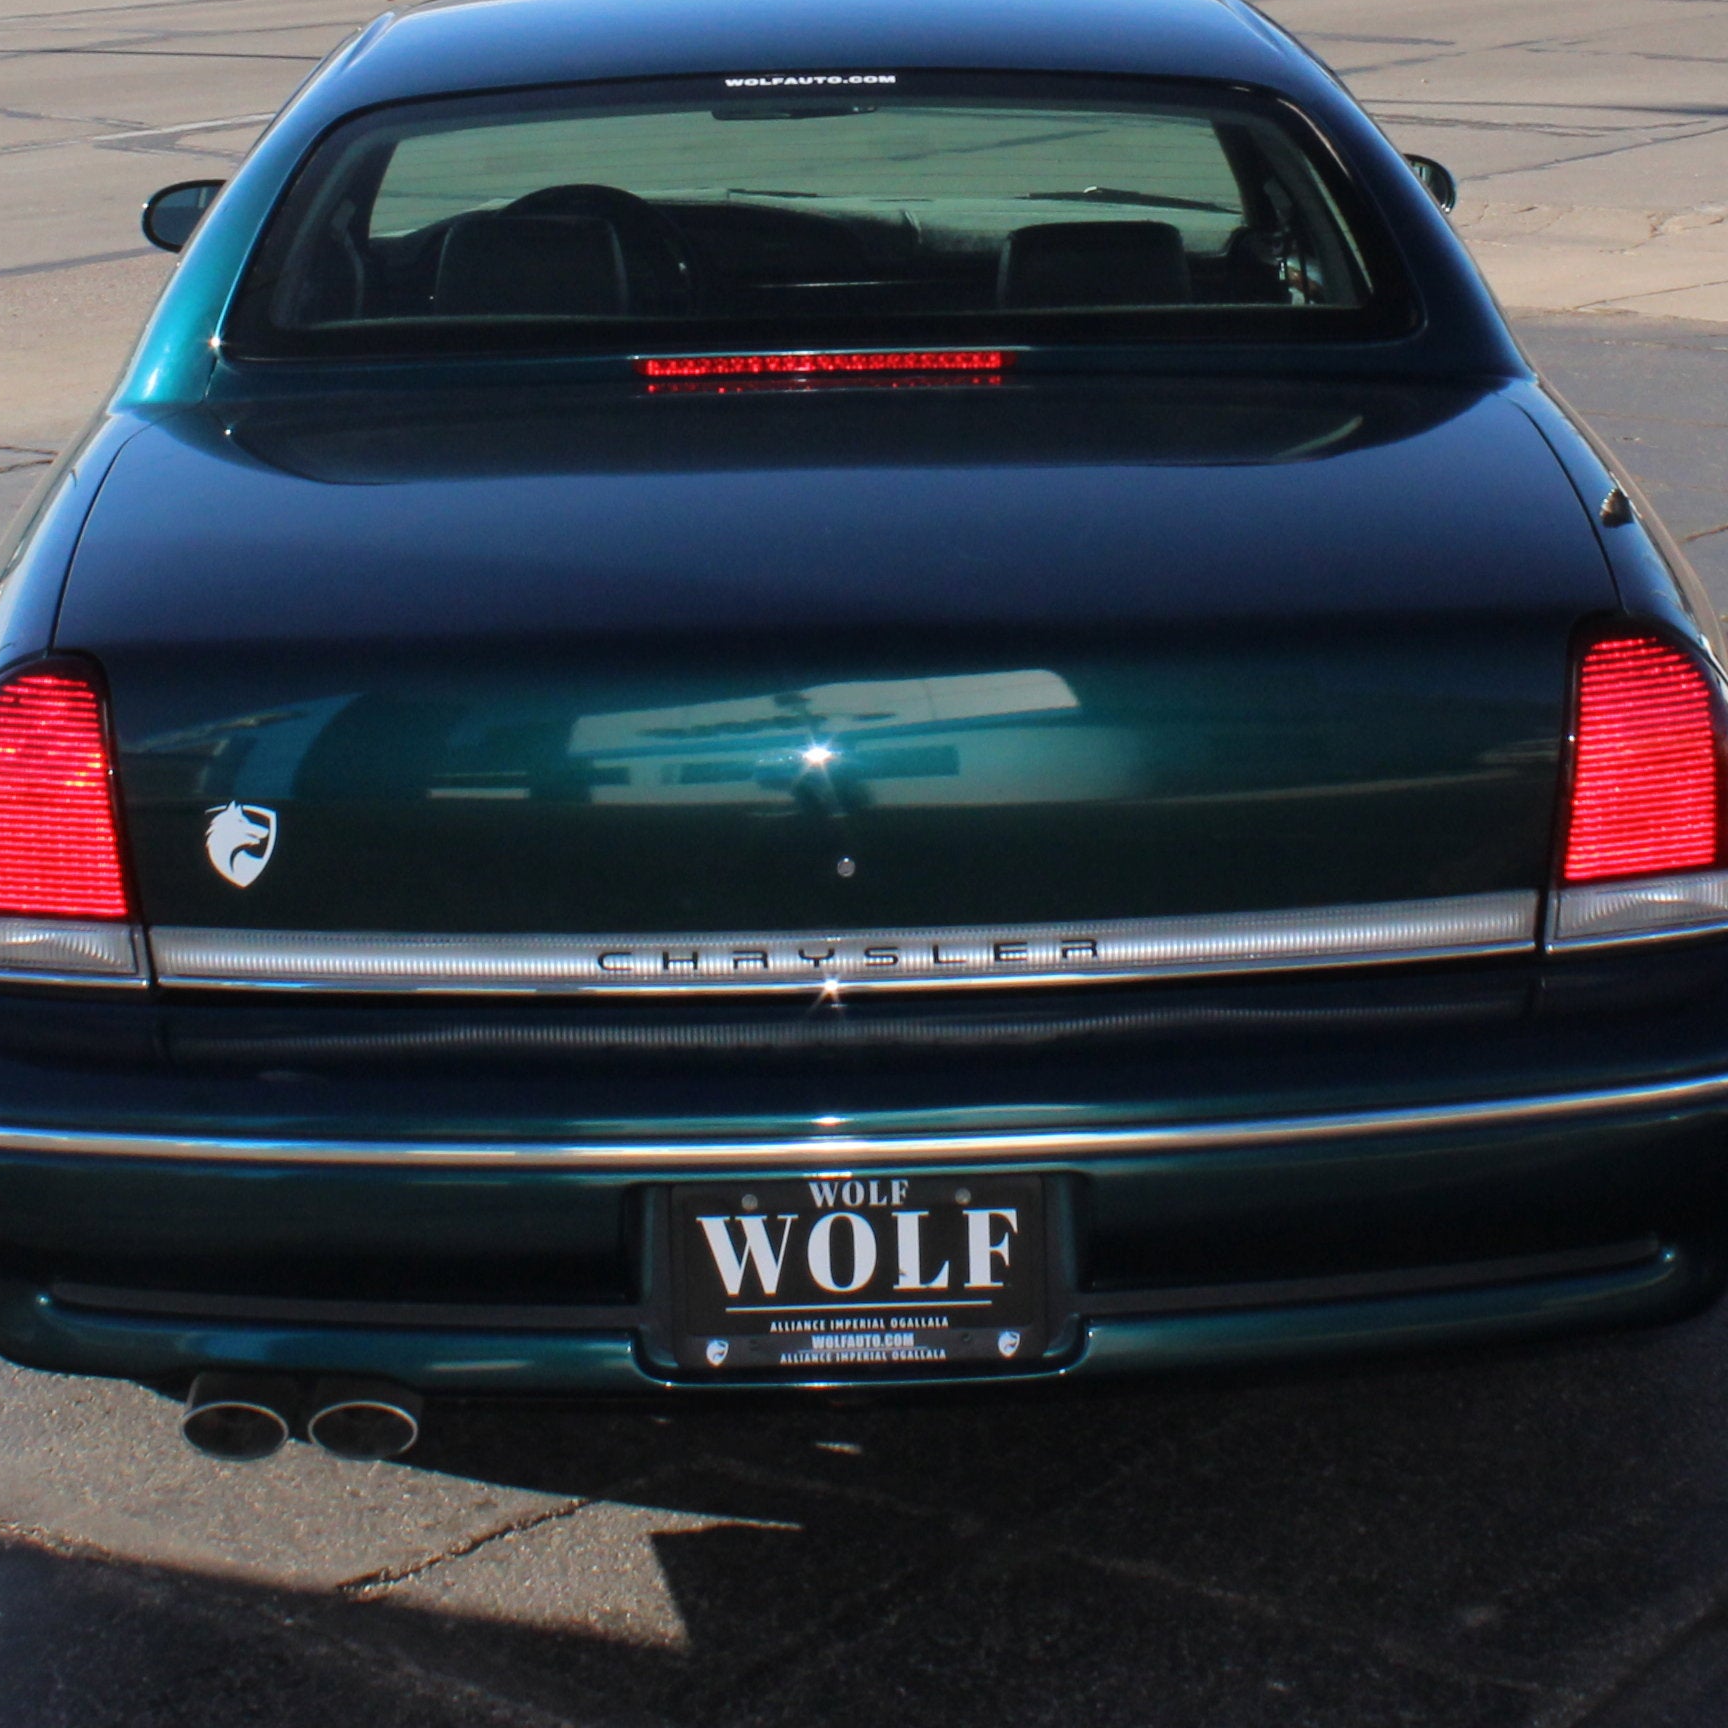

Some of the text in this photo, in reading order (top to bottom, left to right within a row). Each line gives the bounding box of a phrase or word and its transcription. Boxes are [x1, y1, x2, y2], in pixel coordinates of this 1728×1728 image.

[725, 75, 897, 87] WOLFAUTO.COM
[597, 939, 1098, 971] CHRYSLER
[809, 1179, 909, 1208] WOLF
[696, 1208, 1018, 1297] WOLF
[770, 1316, 949, 1332] ALLIANCE IMPERIAL OGALLALA
[811, 1333, 915, 1349] WOLFAUTO.COM
[780, 1349, 947, 1364] ALLIANCE IMPERIAL OGALLALA
